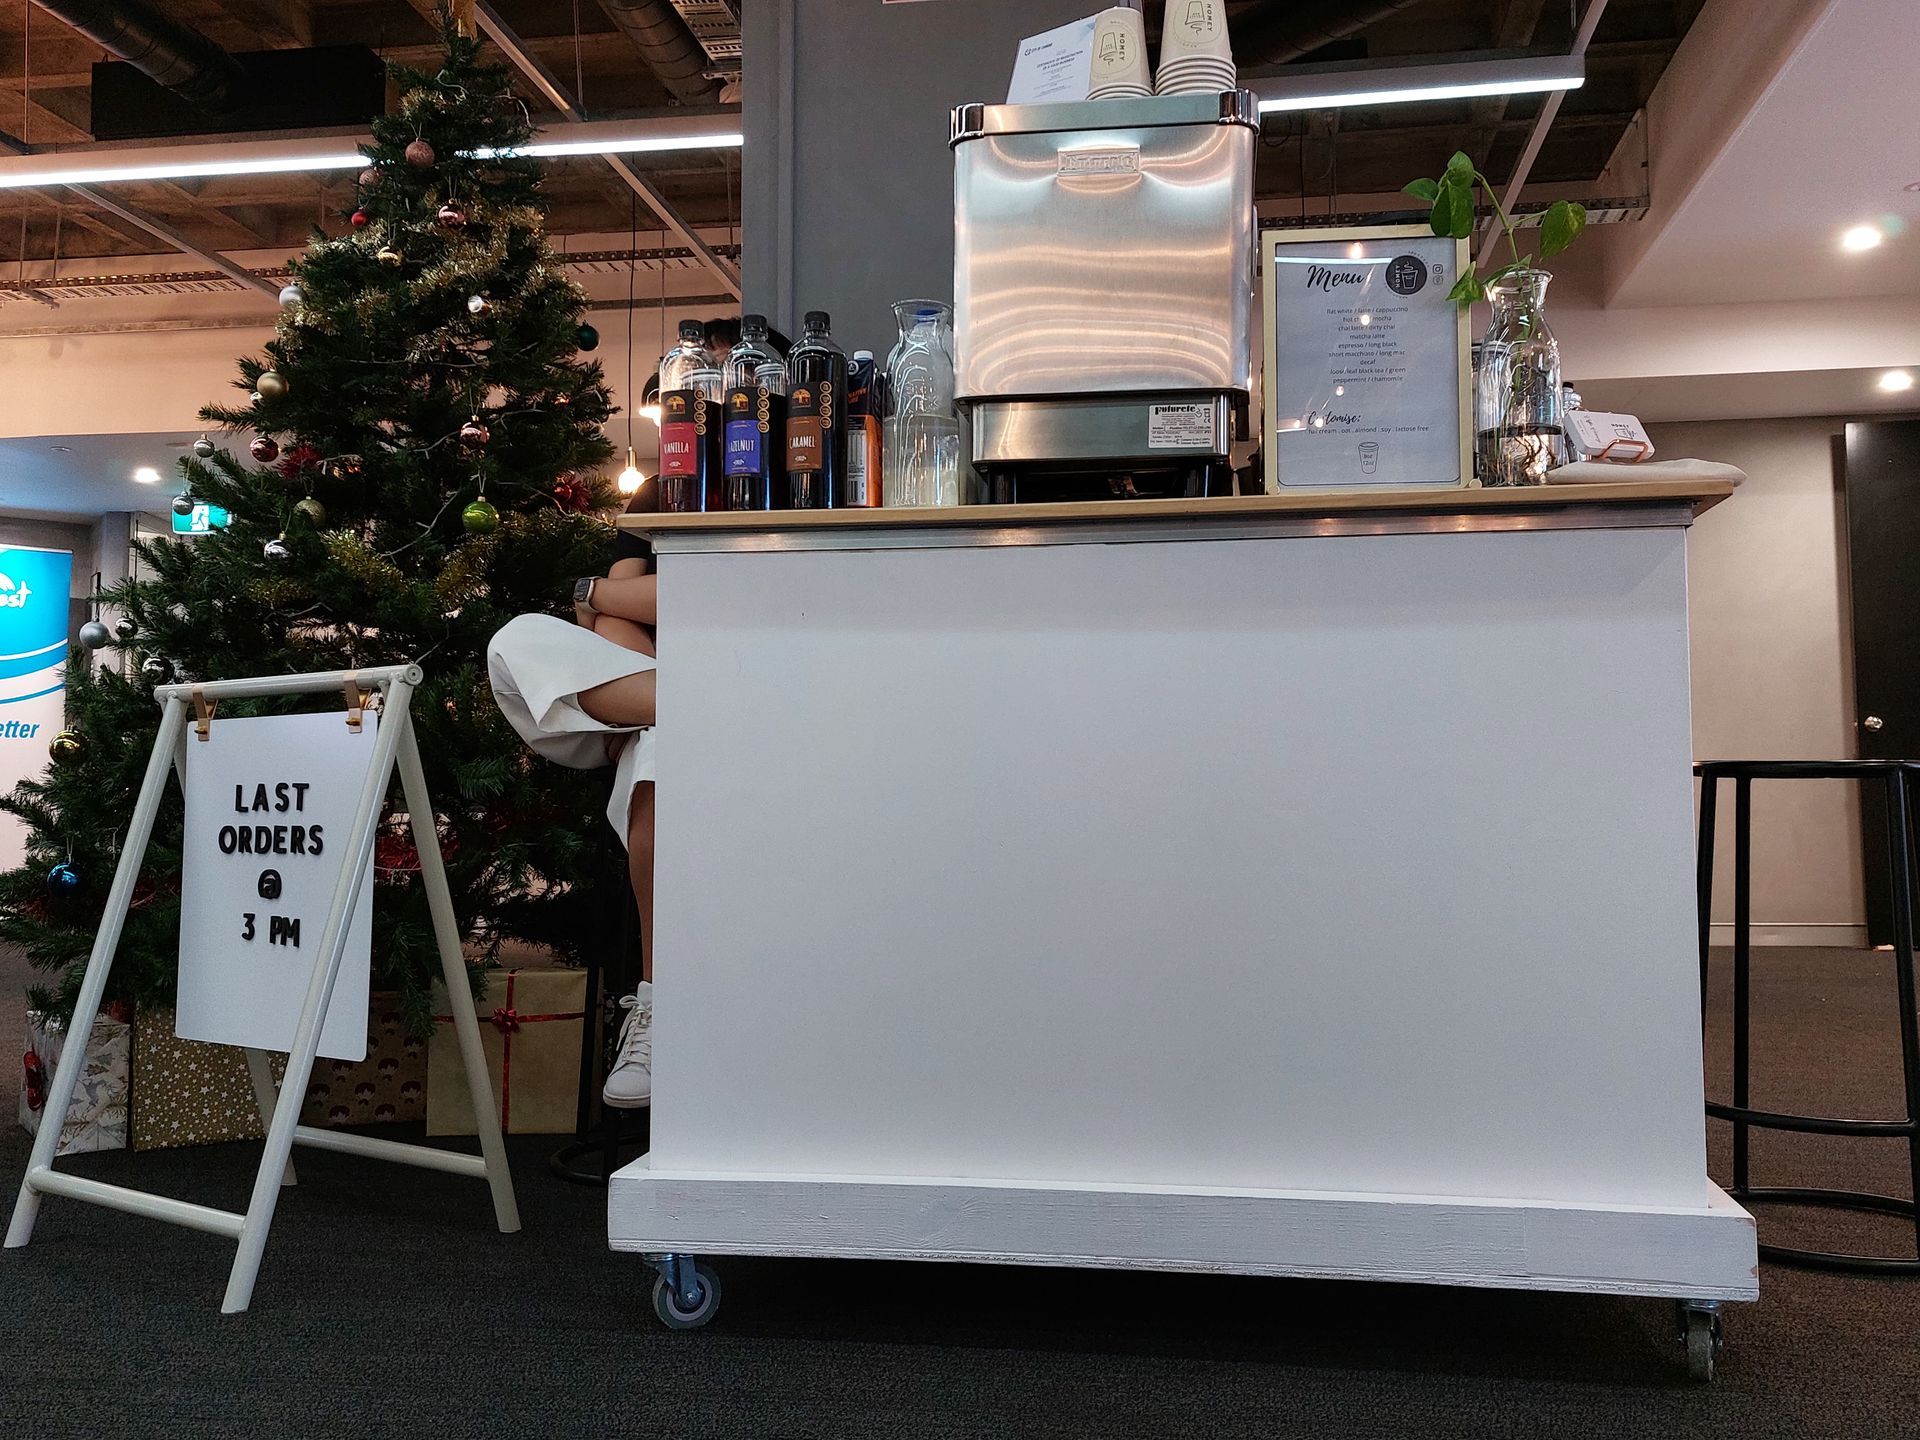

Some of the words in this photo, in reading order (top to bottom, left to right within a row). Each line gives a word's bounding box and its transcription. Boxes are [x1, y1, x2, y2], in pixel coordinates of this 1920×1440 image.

[1307, 264, 1365, 292] Menu
[1376, 306, 1408, 314] cappuccino
[1332, 376, 1366, 384] peppermint
[663, 441, 689, 454] VANILLA
[789, 435, 816, 449] CARAMEL
[235, 782, 310, 813] LAST
[218, 825, 324, 855] ORDERS
[241, 912, 256, 941] 3
[269, 915, 301, 948] PM
